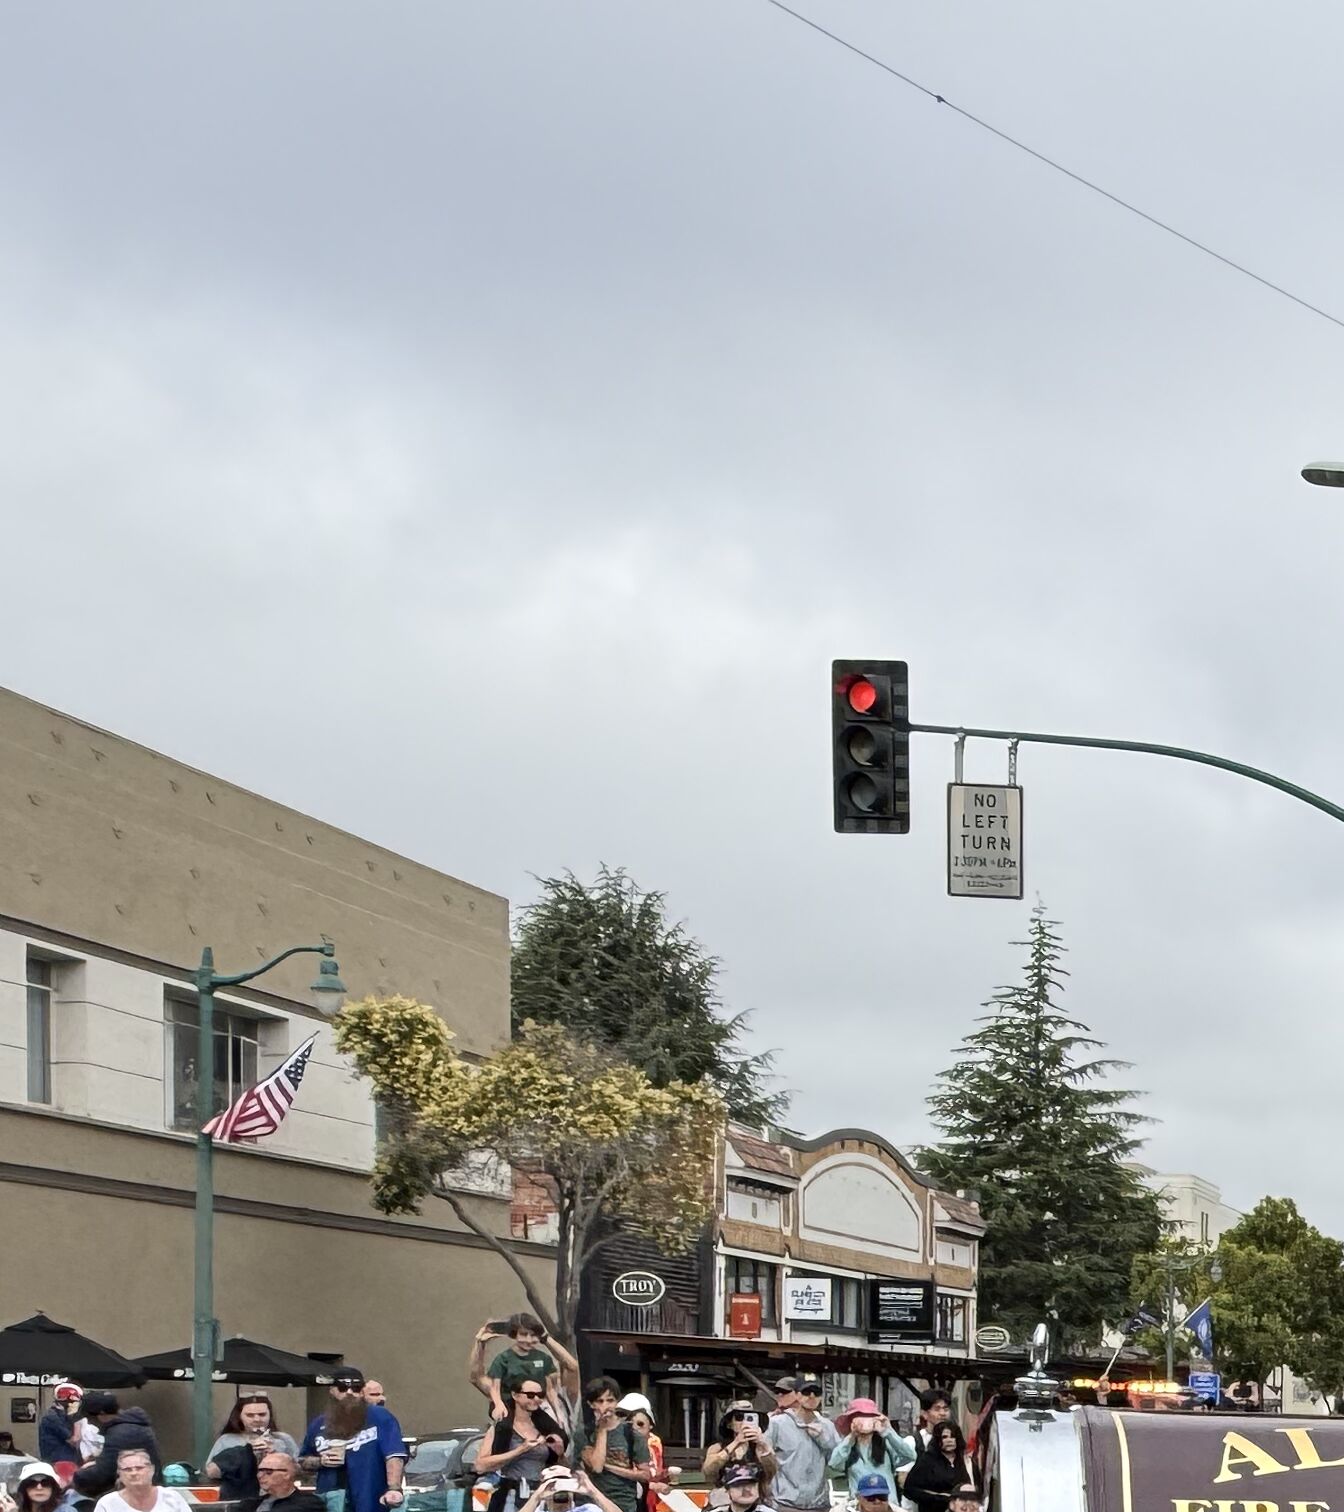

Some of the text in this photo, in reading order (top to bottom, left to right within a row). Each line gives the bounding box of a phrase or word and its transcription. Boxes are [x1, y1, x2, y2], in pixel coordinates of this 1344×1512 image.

[974, 793, 996, 808] NO
[962, 813, 1009, 829] LEFT
[960, 834, 1011, 850] TURN
[619, 1279, 657, 1293] TROY
